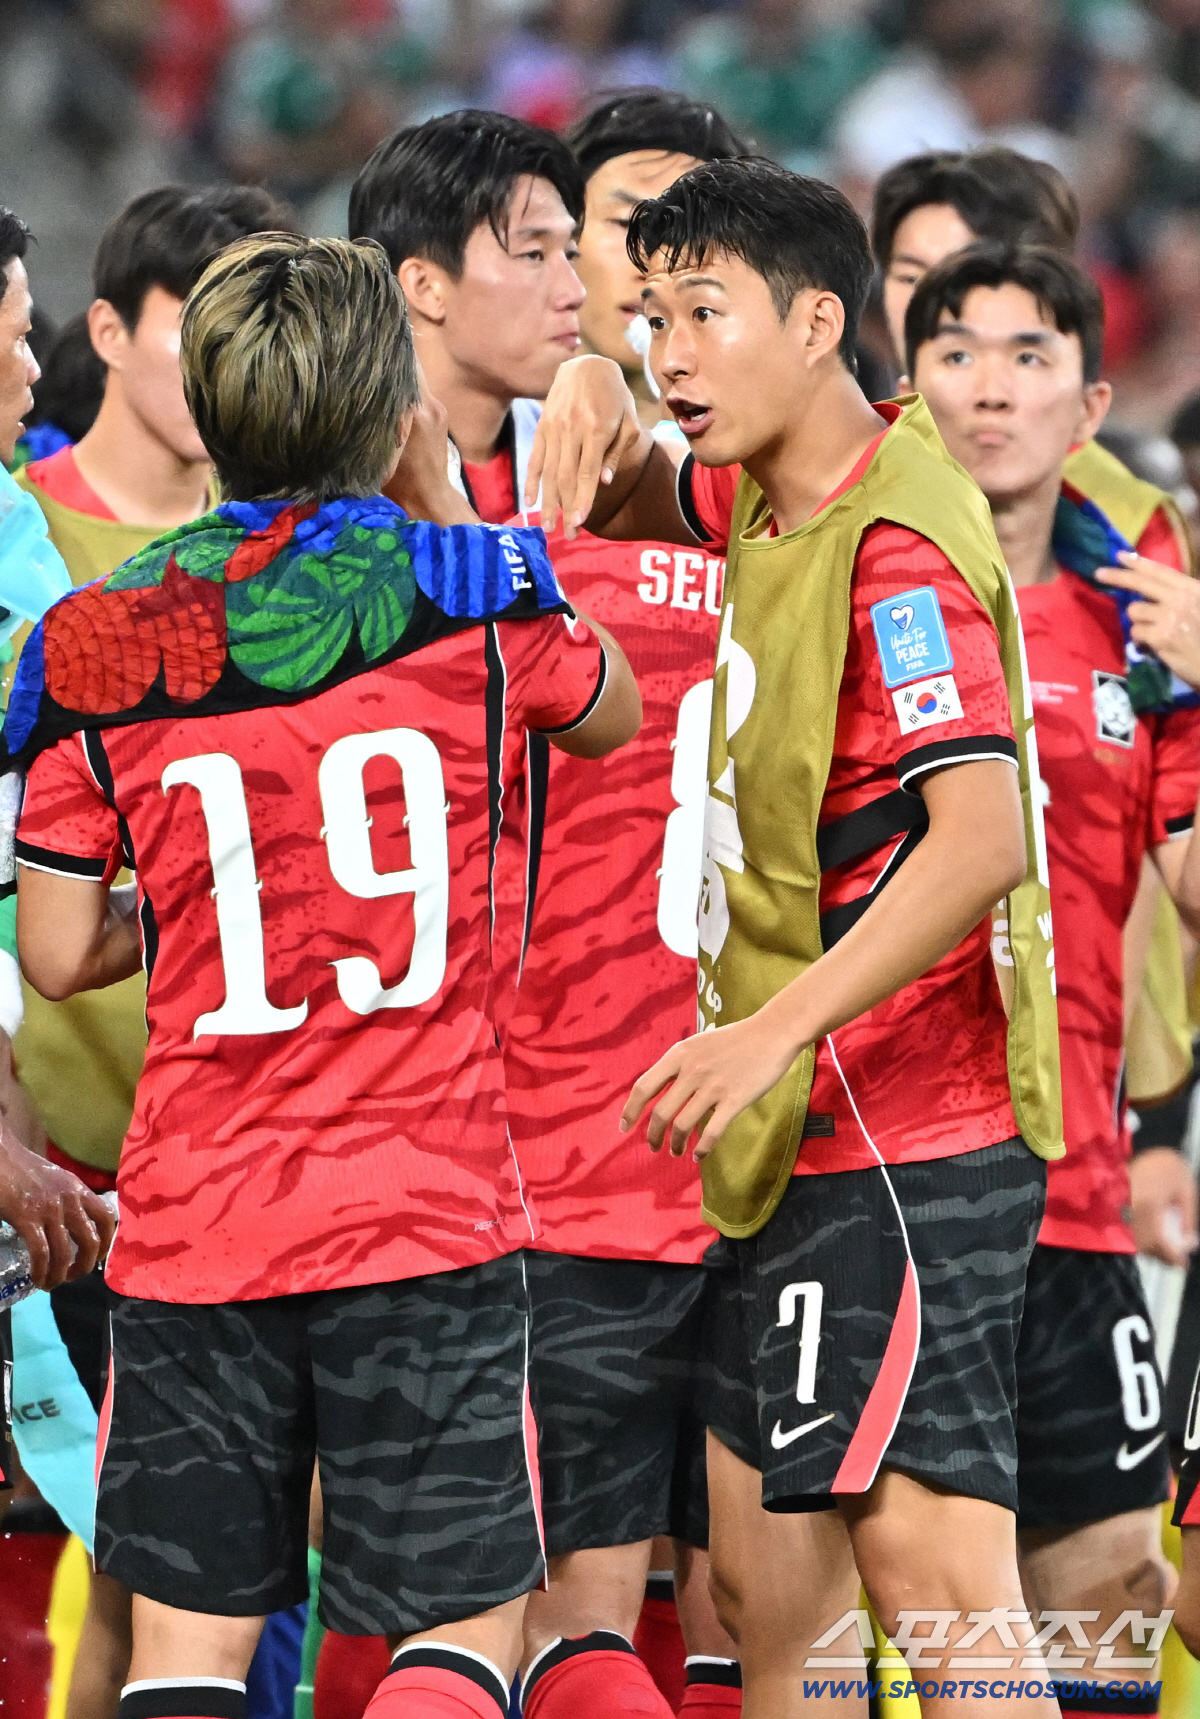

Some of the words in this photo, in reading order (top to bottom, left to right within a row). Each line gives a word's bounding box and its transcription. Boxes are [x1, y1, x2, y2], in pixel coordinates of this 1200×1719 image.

[498, 534, 532, 590] FIFA
[890, 632, 914, 650] Unite
[912, 626, 928, 643] For
[895, 641, 930, 664] PEACE
[905, 660, 925, 671] FIFA
[160, 727, 451, 1044] 19
[775, 1281, 824, 1404] 7
[1112, 1314, 1161, 1431] 6
